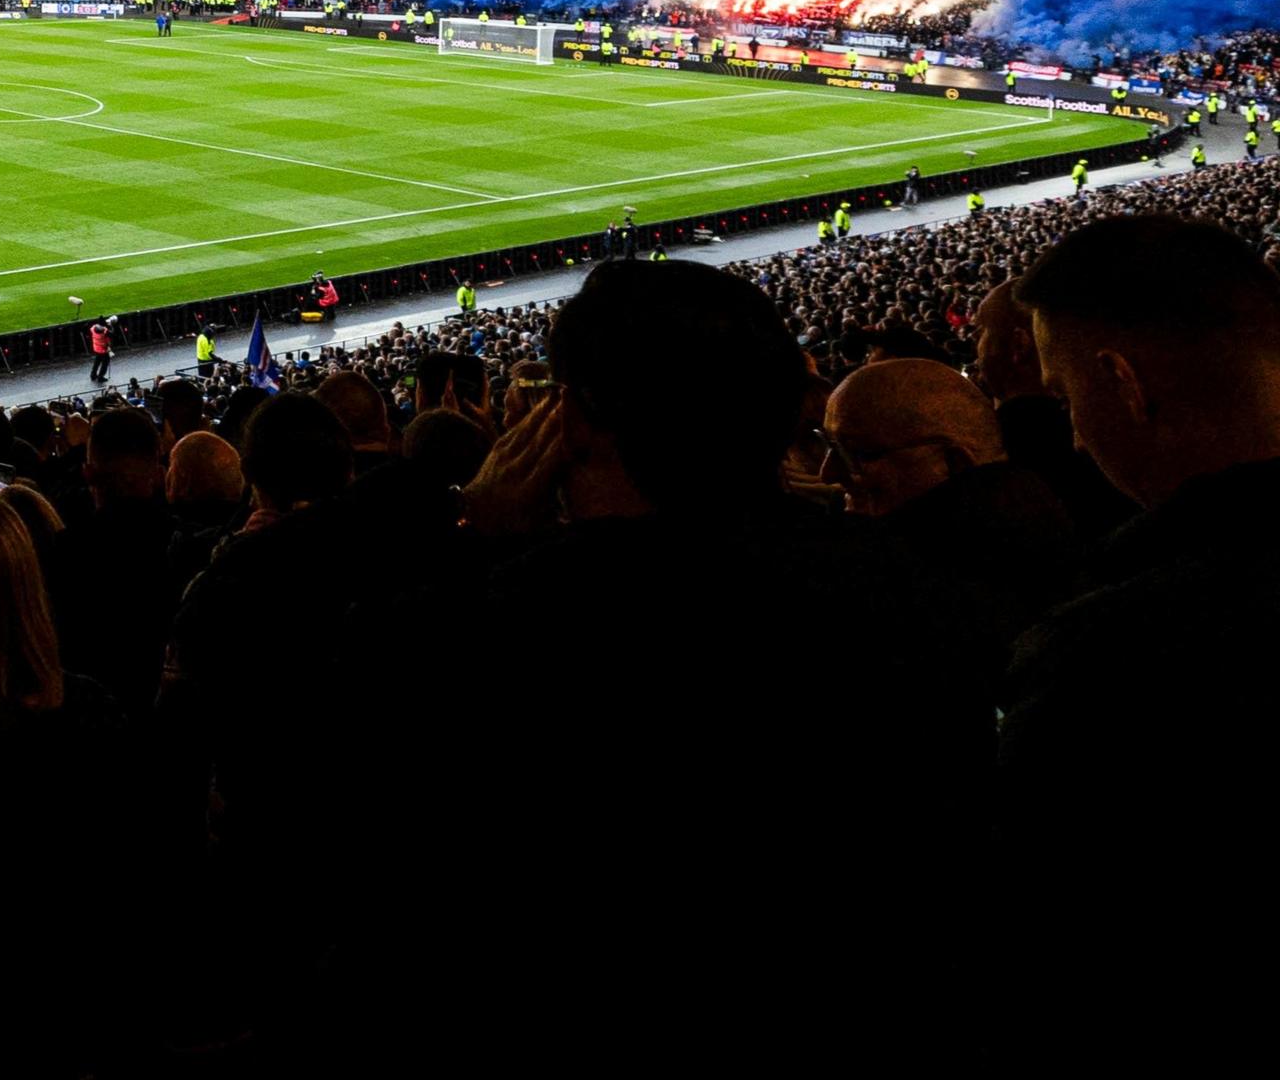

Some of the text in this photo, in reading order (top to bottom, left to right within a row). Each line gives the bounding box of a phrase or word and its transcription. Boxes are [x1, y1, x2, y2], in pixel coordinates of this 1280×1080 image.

[1005, 94, 1054, 109] Scottish
[1056, 99, 1109, 114] Football.
[1112, 105, 1134, 117] All.
